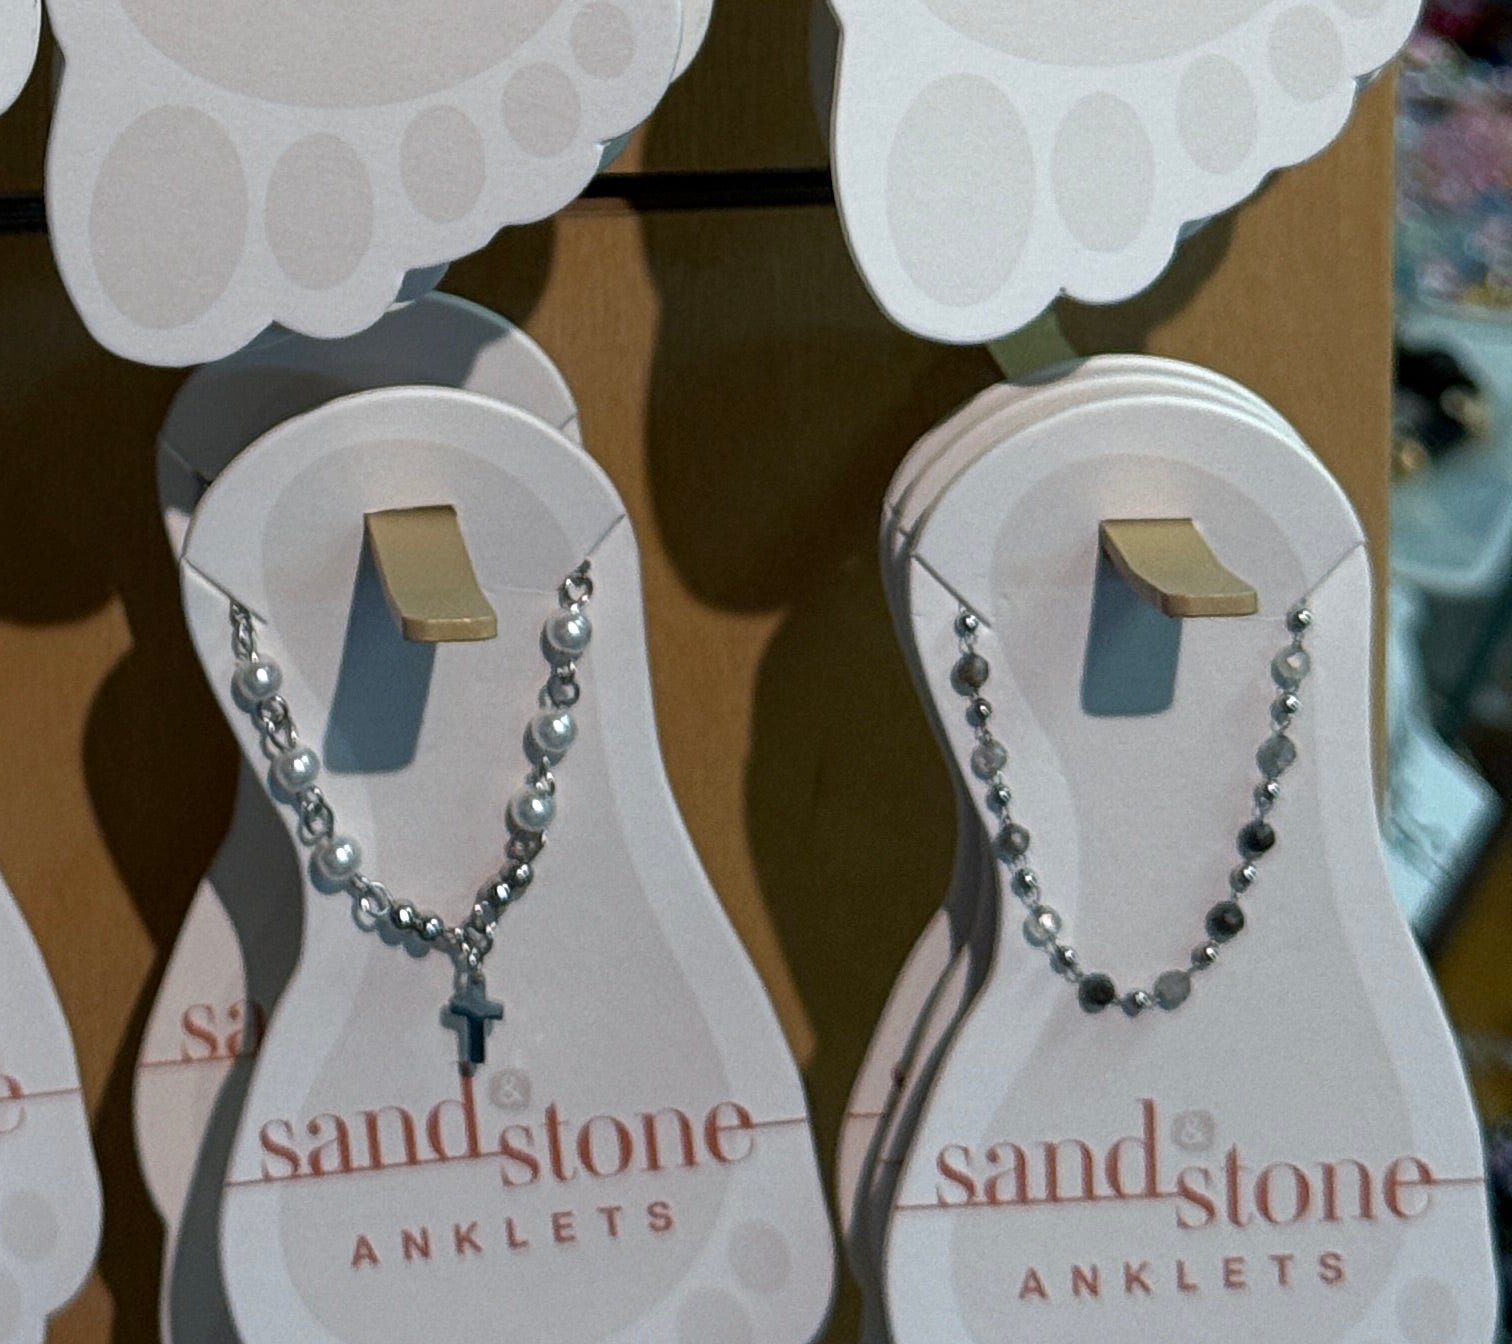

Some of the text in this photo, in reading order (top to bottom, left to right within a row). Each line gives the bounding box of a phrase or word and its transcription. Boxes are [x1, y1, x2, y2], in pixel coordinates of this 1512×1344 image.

[259, 1075, 480, 1181] sand
[498, 1101, 755, 1189] stone
[935, 1097, 1158, 1206] sand
[1175, 1141, 1435, 1231] stone
[350, 1201, 675, 1270] ANKLETS
[1017, 1252, 1347, 1301] ANKLETS
